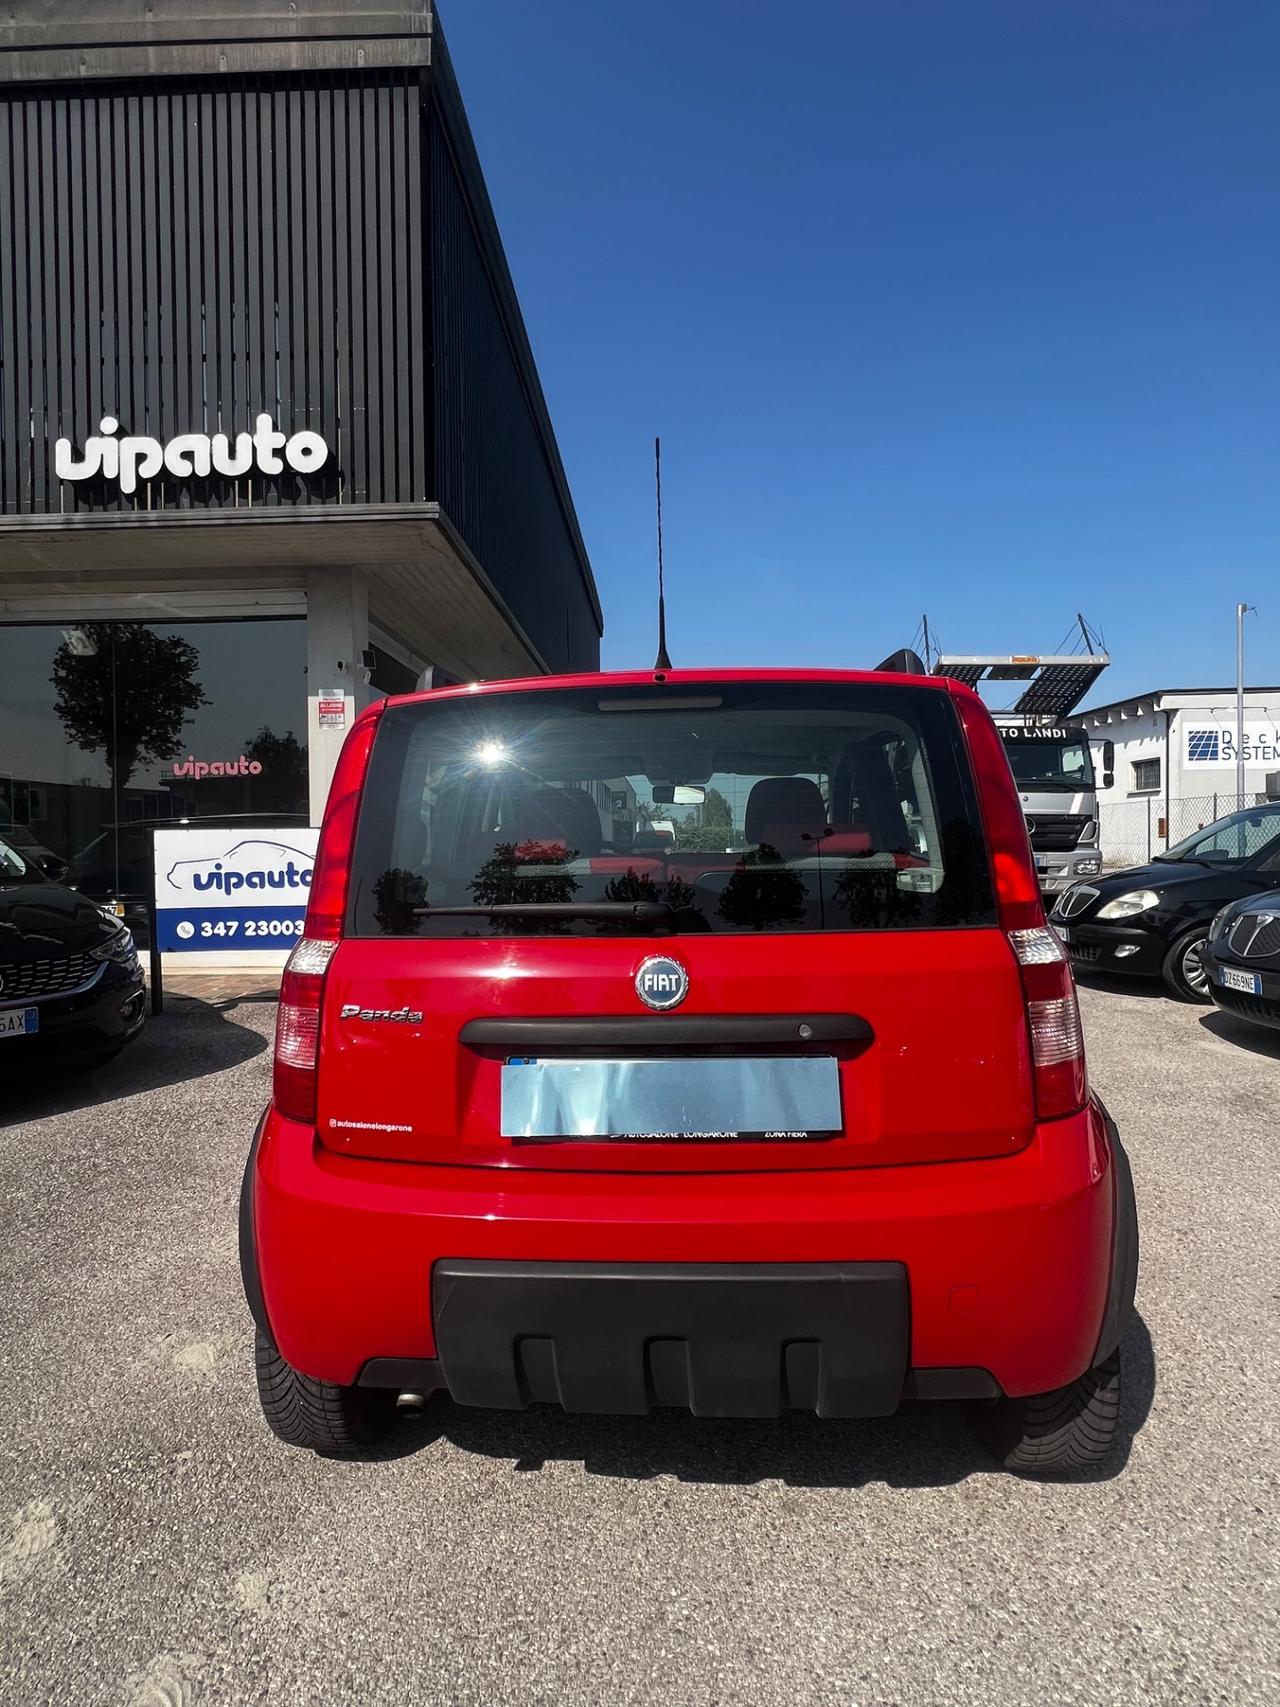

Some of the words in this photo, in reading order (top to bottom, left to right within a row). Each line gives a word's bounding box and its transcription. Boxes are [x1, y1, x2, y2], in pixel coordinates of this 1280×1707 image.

[55, 413, 328, 494] vipauto
[1023, 728, 1066, 738] LANDI
[172, 755, 263, 780] vipauto
[193, 861, 313, 896] vipauto
[201, 921, 239, 937] 347
[244, 920, 305, 936] 23003
[644, 974, 679, 992] FIAT
[340, 1004, 424, 1024] Panda
